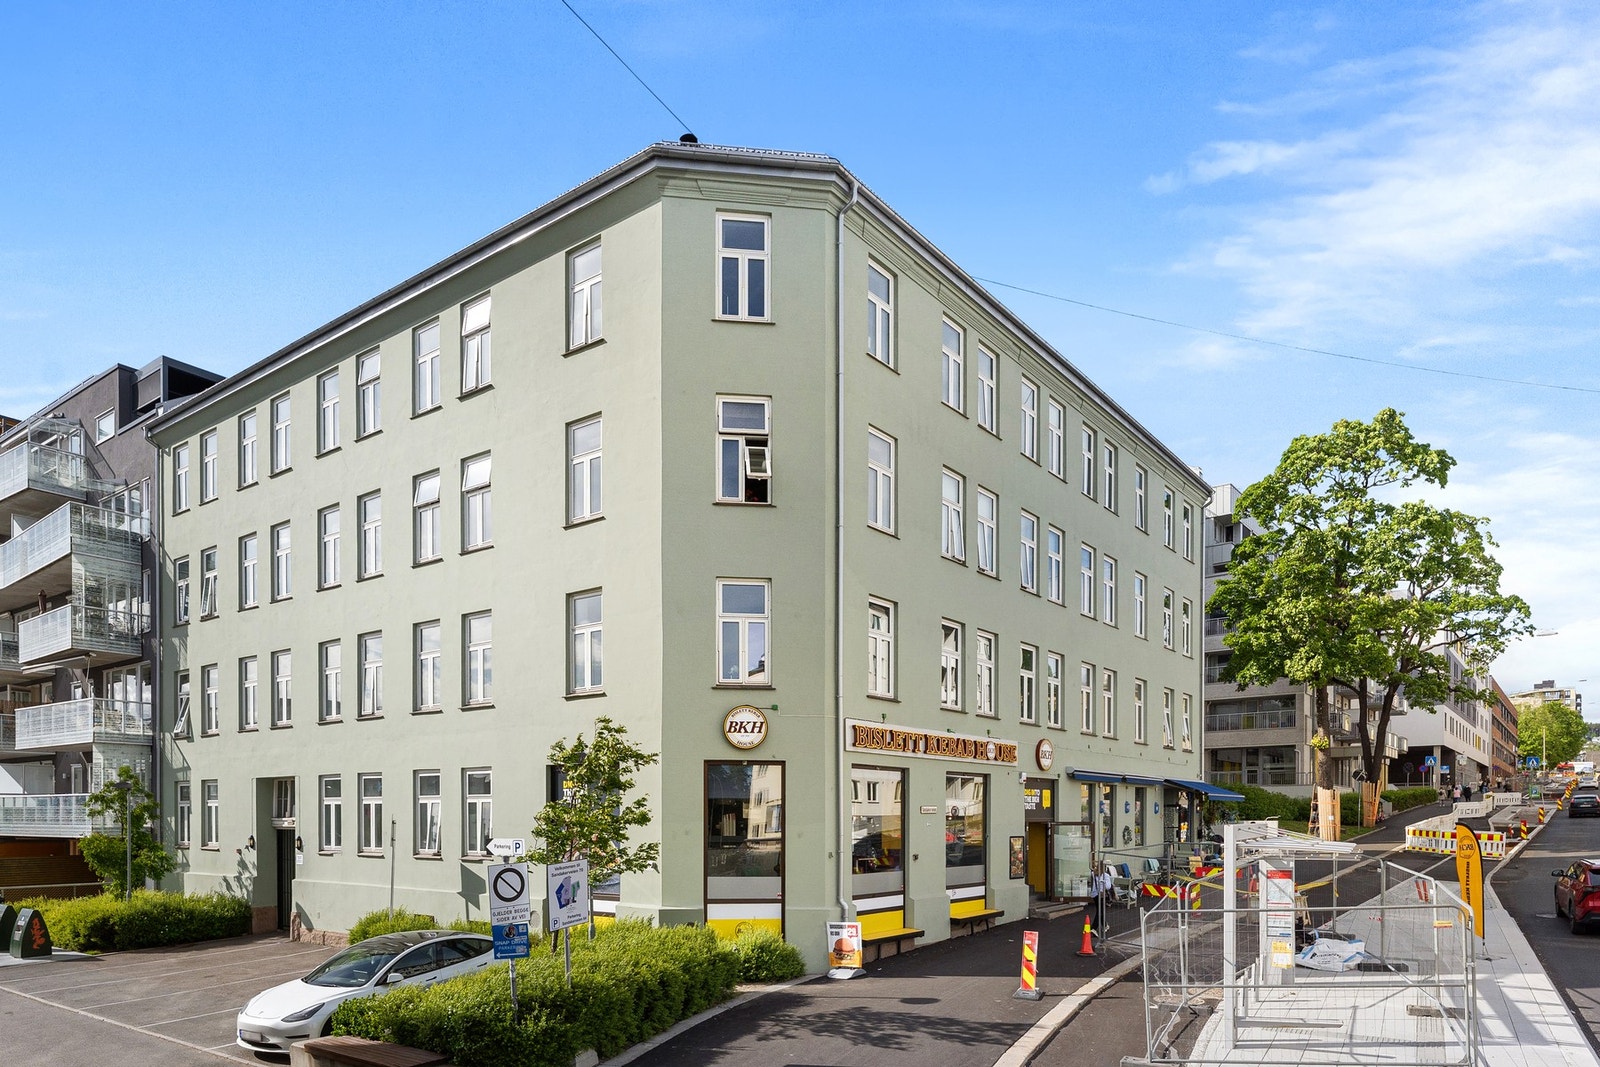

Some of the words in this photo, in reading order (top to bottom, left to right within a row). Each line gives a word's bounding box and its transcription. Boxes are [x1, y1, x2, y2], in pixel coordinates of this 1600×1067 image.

[727, 720, 765, 733] BKH
[853, 724, 924, 752] BISLETT
[924, 734, 975, 759] KEBAB
[975, 740, 1018, 763] HOUSE
[1040, 750, 1053, 760] BKH
[514, 842, 521, 853] P
[553, 919, 558, 928] P
